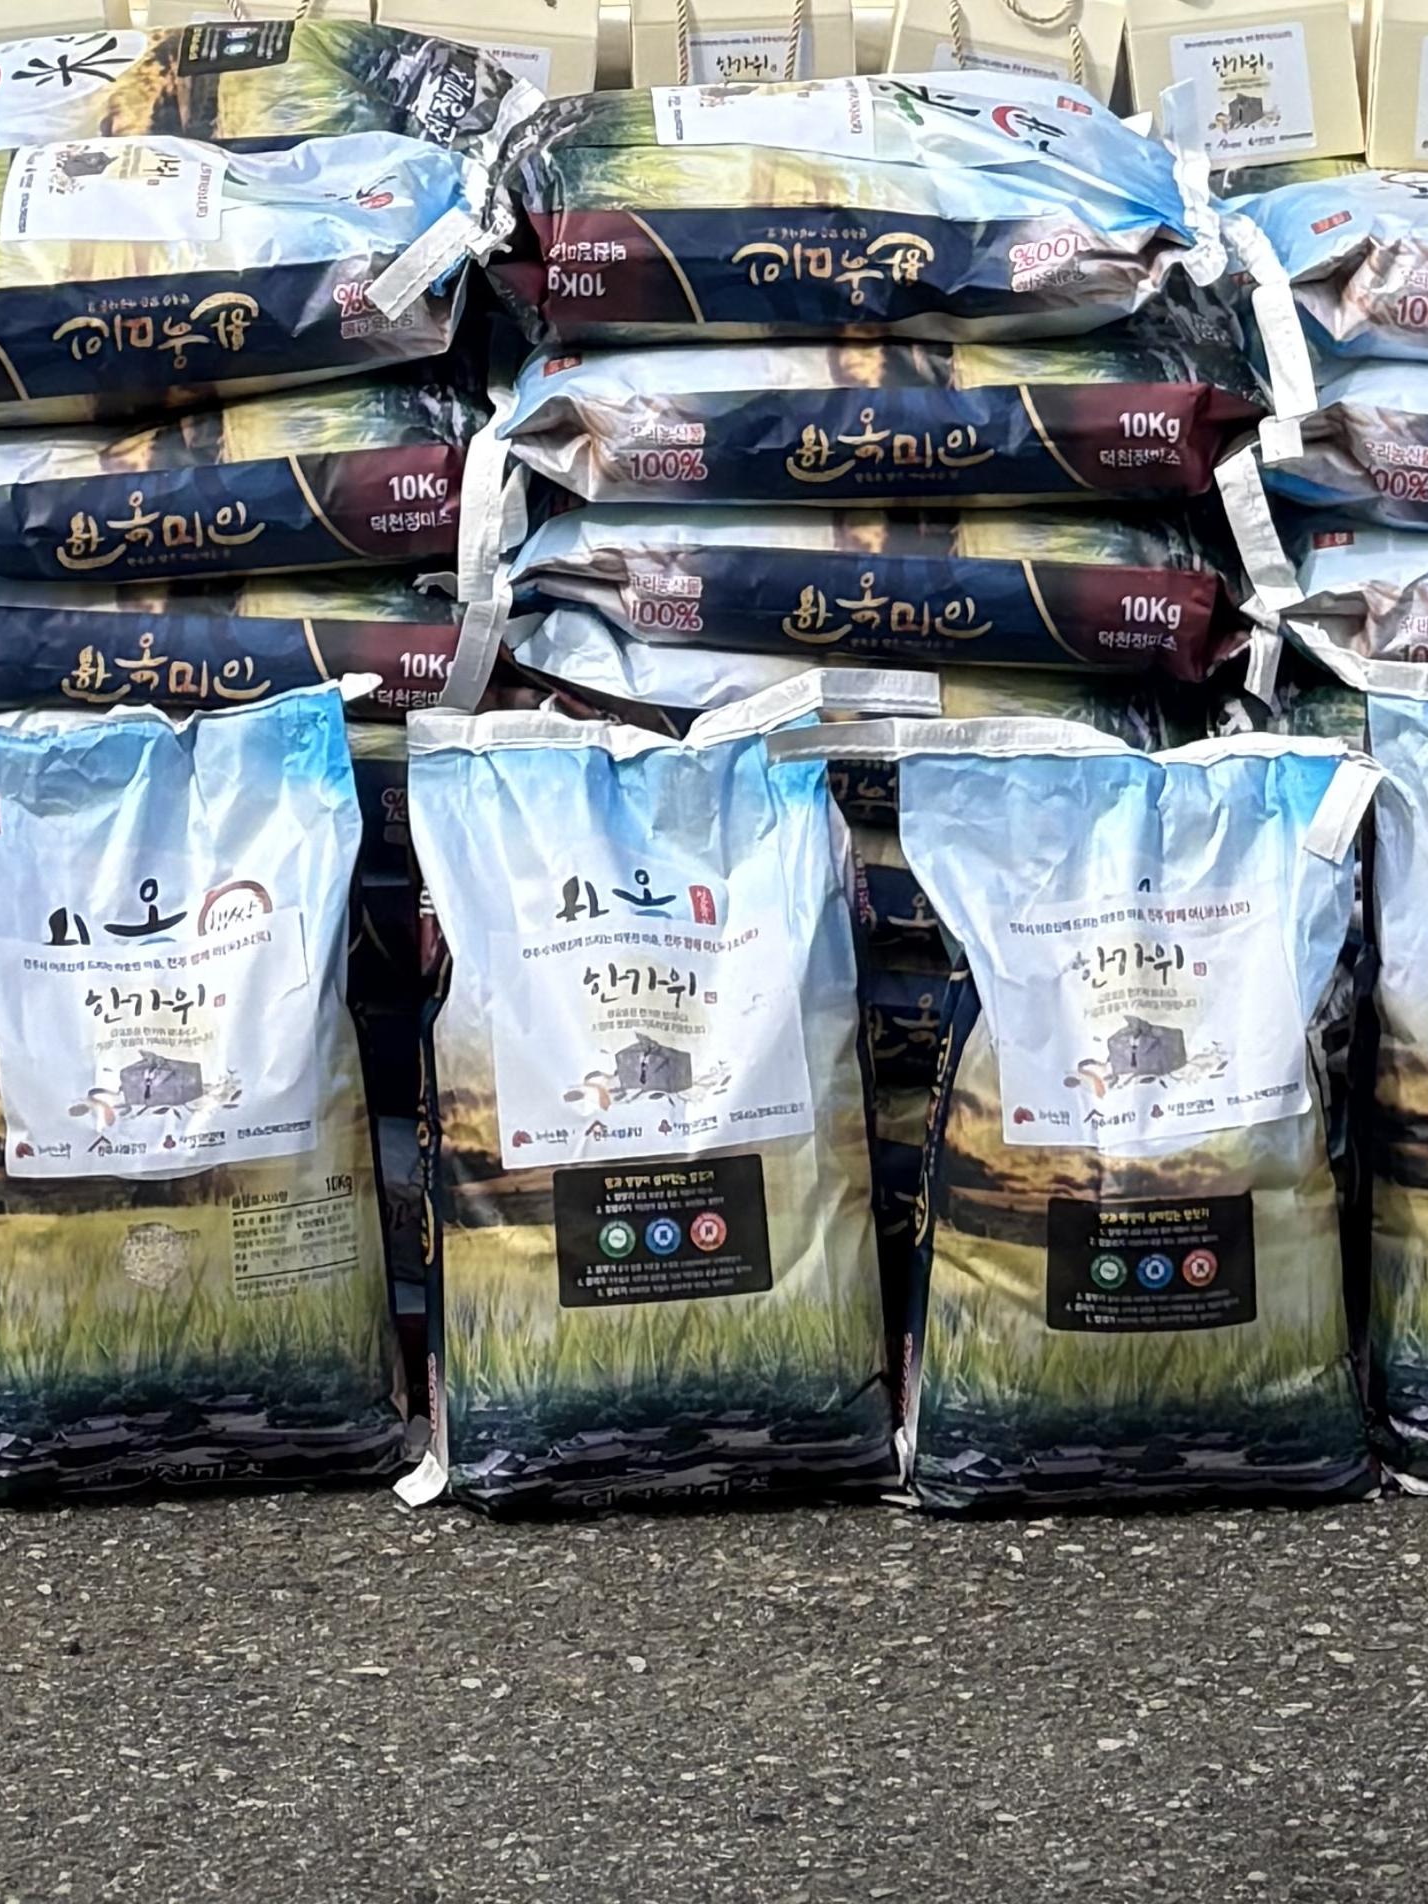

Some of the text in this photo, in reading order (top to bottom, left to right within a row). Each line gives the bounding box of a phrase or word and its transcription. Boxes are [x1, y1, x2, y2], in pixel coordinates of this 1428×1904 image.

[546, 265, 607, 299] 10Kg
[785, 407, 995, 482] 한옥미인
[1118, 412, 1181, 443] 10Kg
[627, 449, 708, 482] 100%
[387, 472, 449, 504] 10Kg
[56, 490, 267, 571] 한옥미인
[628, 599, 704, 632] 100%
[782, 571, 993, 645] 한옥미인
[1120, 596, 1182, 629] 10Kg
[62, 632, 271, 702] 한옥미인
[583, 963, 697, 1009] 한가위
[1072, 943, 1185, 988] 한가위
[85, 983, 206, 1025] 한가위
